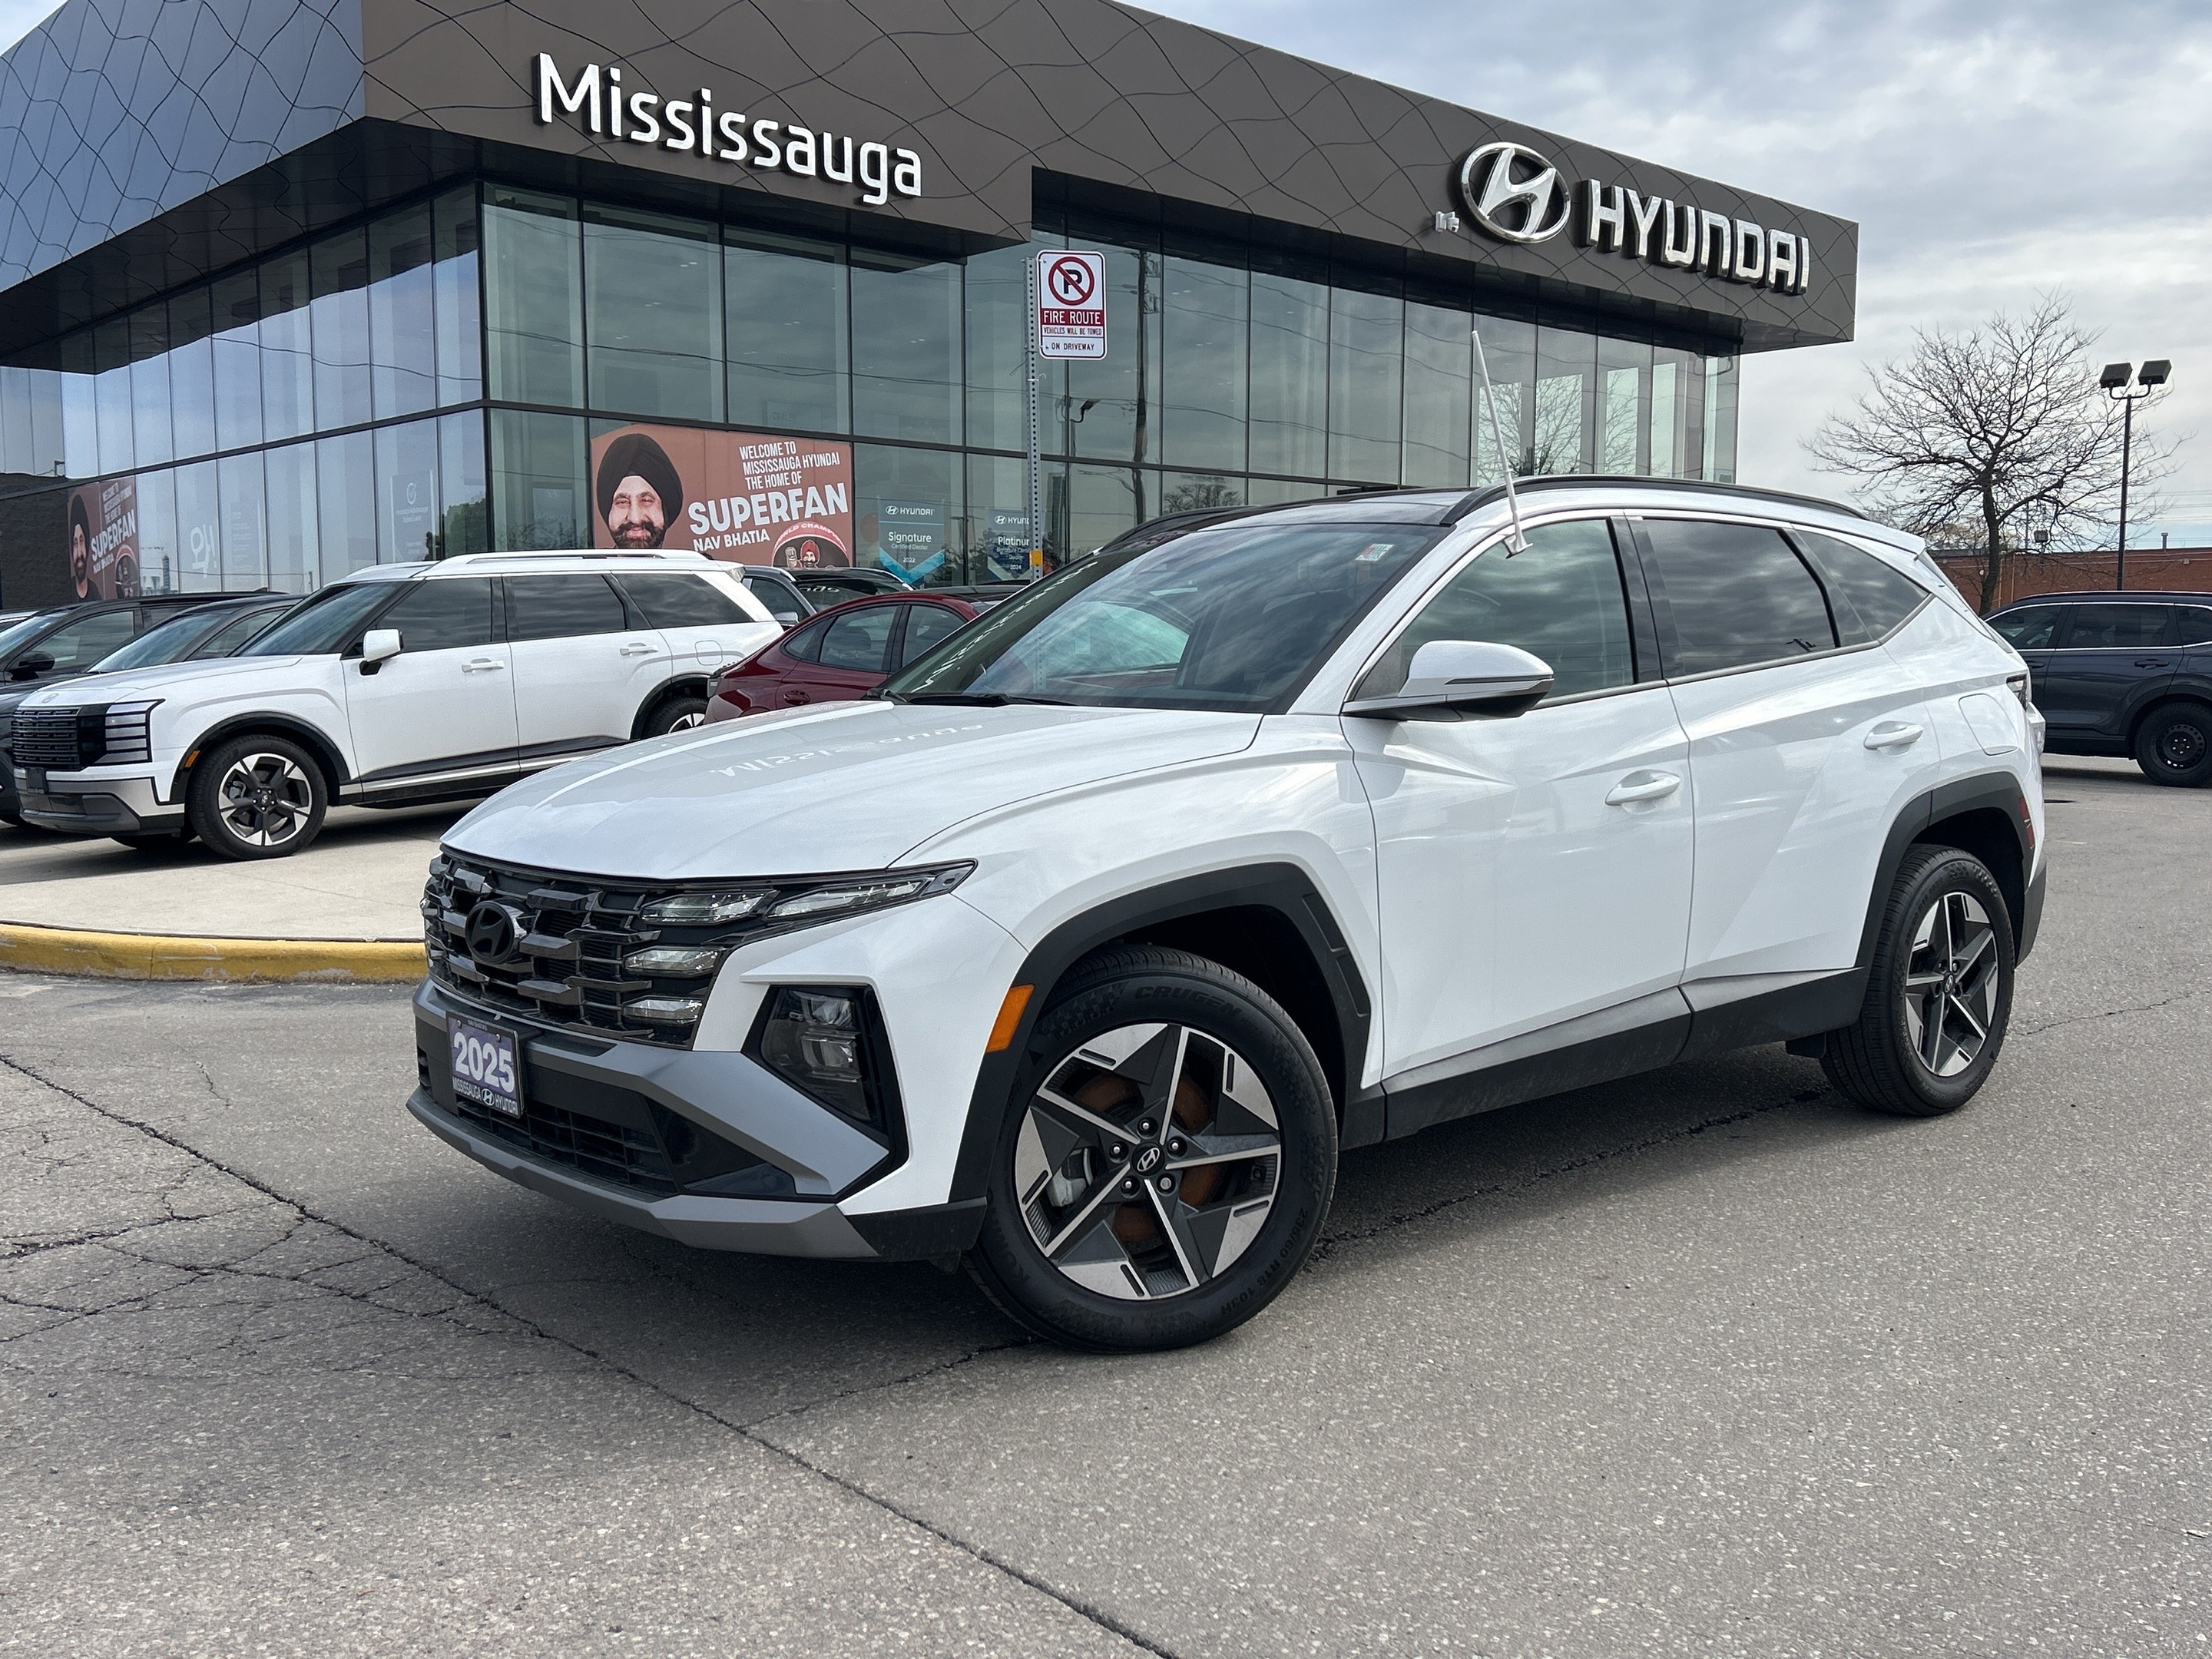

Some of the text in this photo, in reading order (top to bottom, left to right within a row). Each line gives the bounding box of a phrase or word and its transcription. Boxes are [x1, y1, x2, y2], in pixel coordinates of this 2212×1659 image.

[538, 51, 922, 206] Mississauga
[1584, 178, 1810, 295] HYUNDAI
[1043, 310, 1101, 324] FIRE ROUTE
[1043, 326, 1065, 335] VEHICLES
[739, 441, 796, 460] WELCOME TO
[743, 452, 840, 475] MISSISSAUGA HYUNDAI
[745, 471, 802, 491] THE HOME OF
[687, 482, 849, 535] SUPERFAN
[899, 507, 933, 515] HYUNDAI
[91, 508, 136, 562] SUPERFAN
[693, 528, 770, 552] NAV BHATIA
[888, 531, 932, 544] Signature
[1134, 985, 1243, 1016] CRUGEN
[453, 1031, 515, 1093] 2025
[452, 1076, 518, 1115] MISSISSAUGA HYUNDAI
[1280, 1207, 1308, 1259] 235/60
[1257, 1258, 1280, 1286] R18
